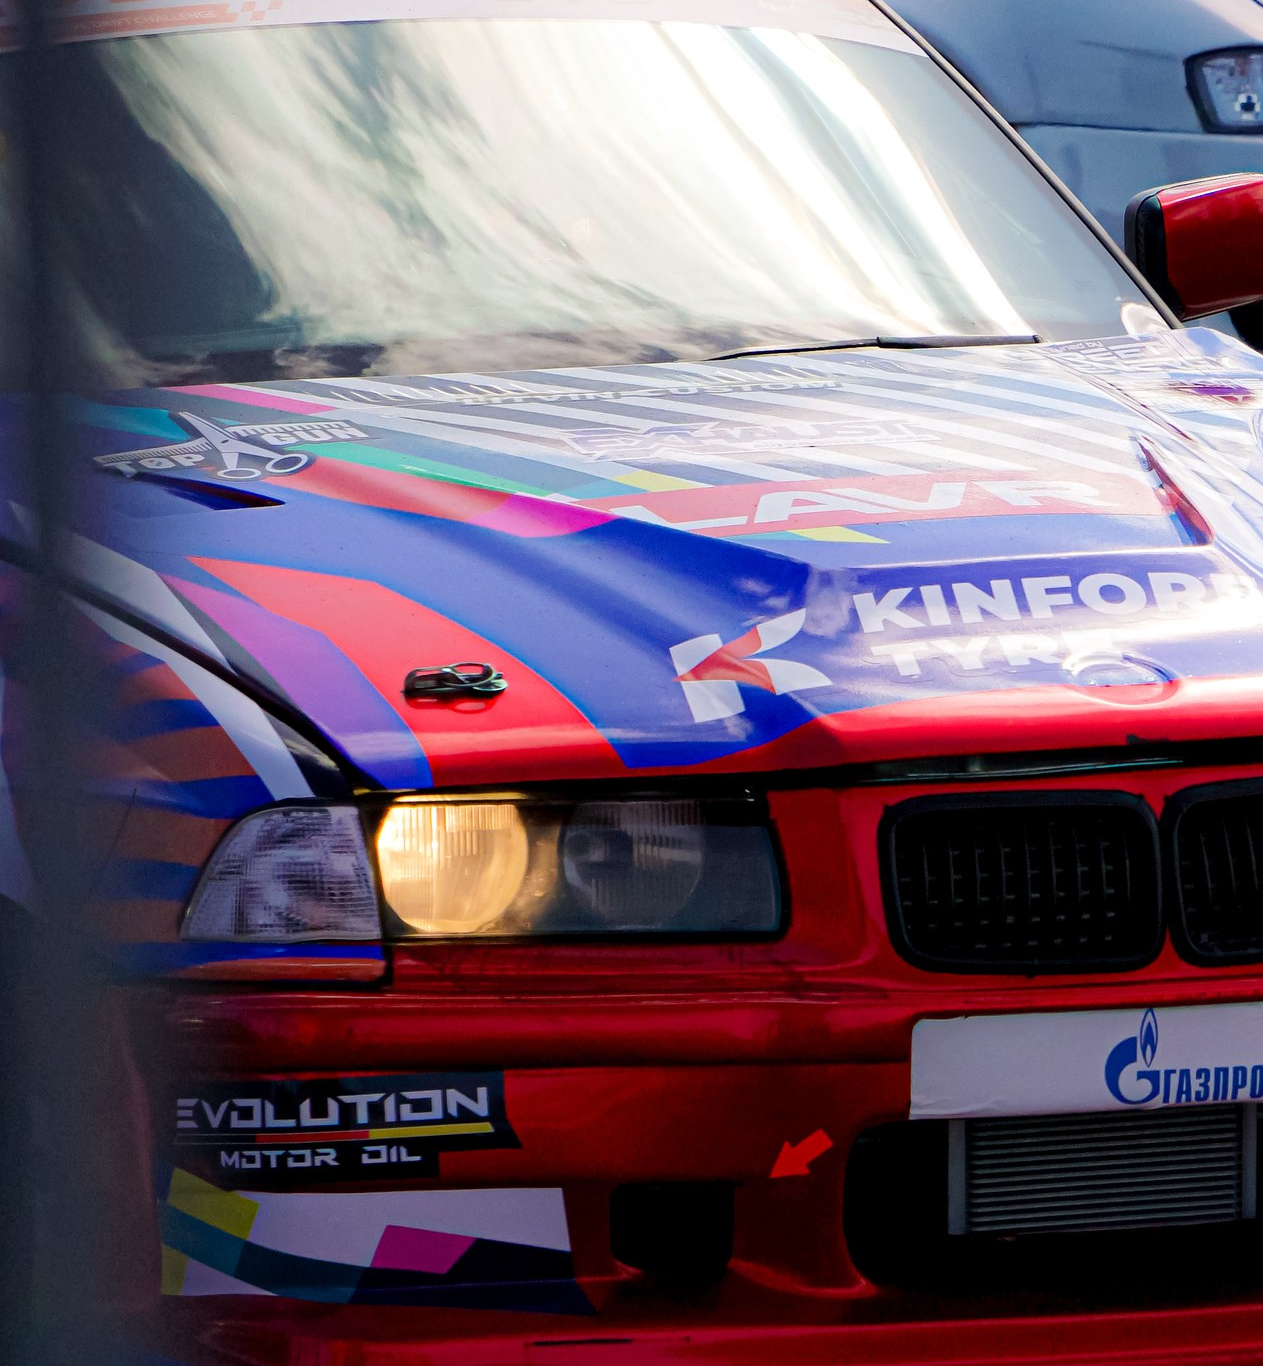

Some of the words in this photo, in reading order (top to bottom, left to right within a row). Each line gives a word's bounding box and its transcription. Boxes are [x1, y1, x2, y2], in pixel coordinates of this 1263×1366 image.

[133, 10, 219, 26] CHALLENGE
[640, 381, 839, 397] CUSTOM
[262, 427, 370, 446] GUN
[102, 454, 206, 478] TOP
[610, 479, 1121, 532] LAVR
[176, 1086, 490, 1129] EVOLUTION
[220, 1147, 340, 1169] MOTOR
[361, 1145, 422, 1165] OIL
